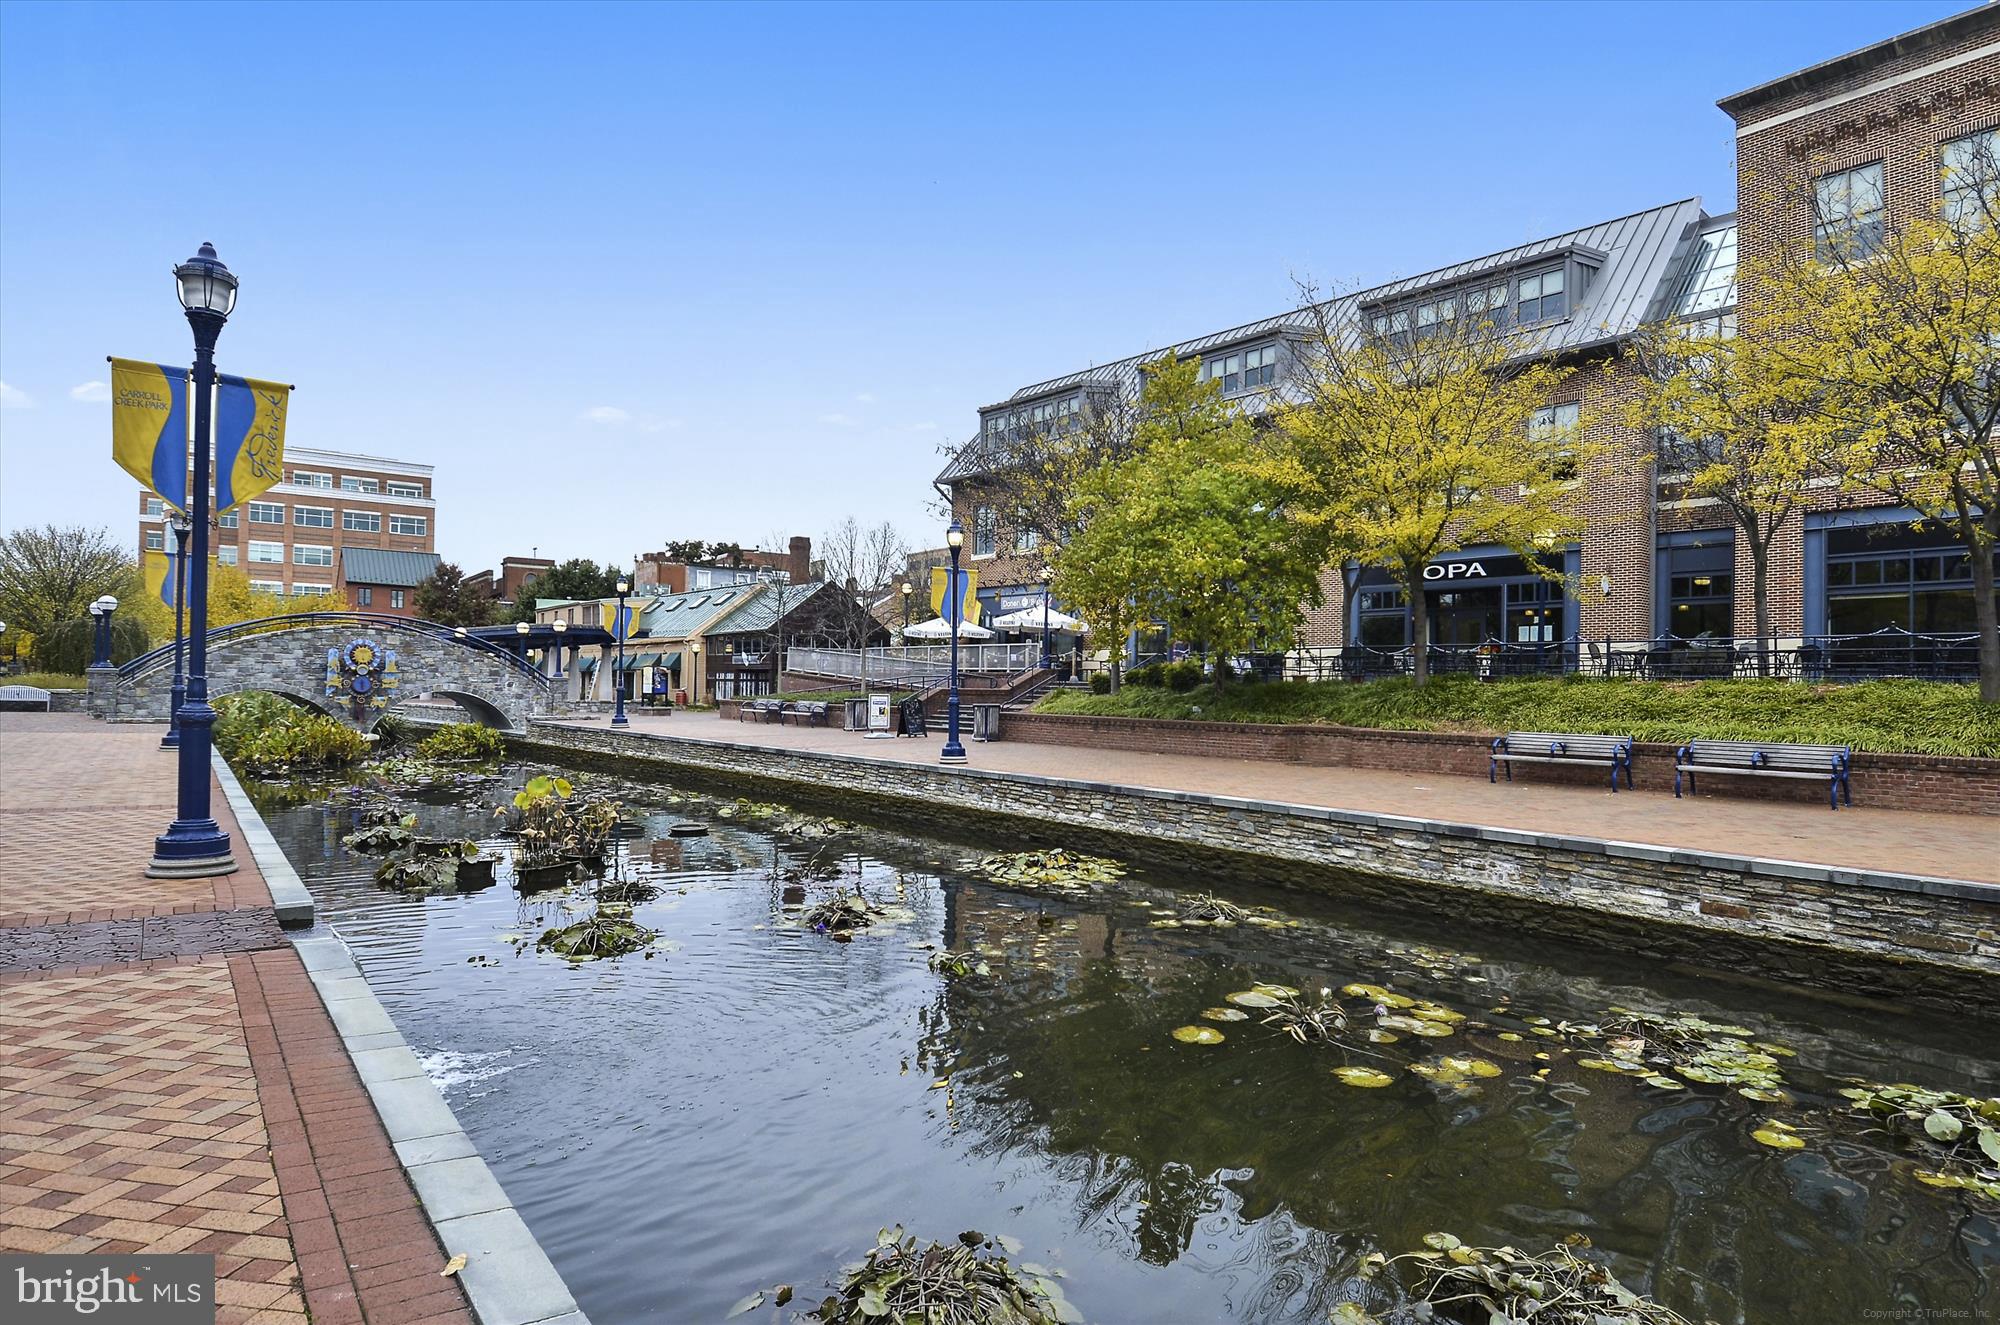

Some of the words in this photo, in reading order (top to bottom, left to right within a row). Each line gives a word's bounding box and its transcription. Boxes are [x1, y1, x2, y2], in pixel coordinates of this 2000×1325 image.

[120, 388, 161, 401] CARROLL
[115, 397, 144, 408] CREEK
[145, 400, 168, 411] PARK
[1423, 562, 1487, 580] OPA
